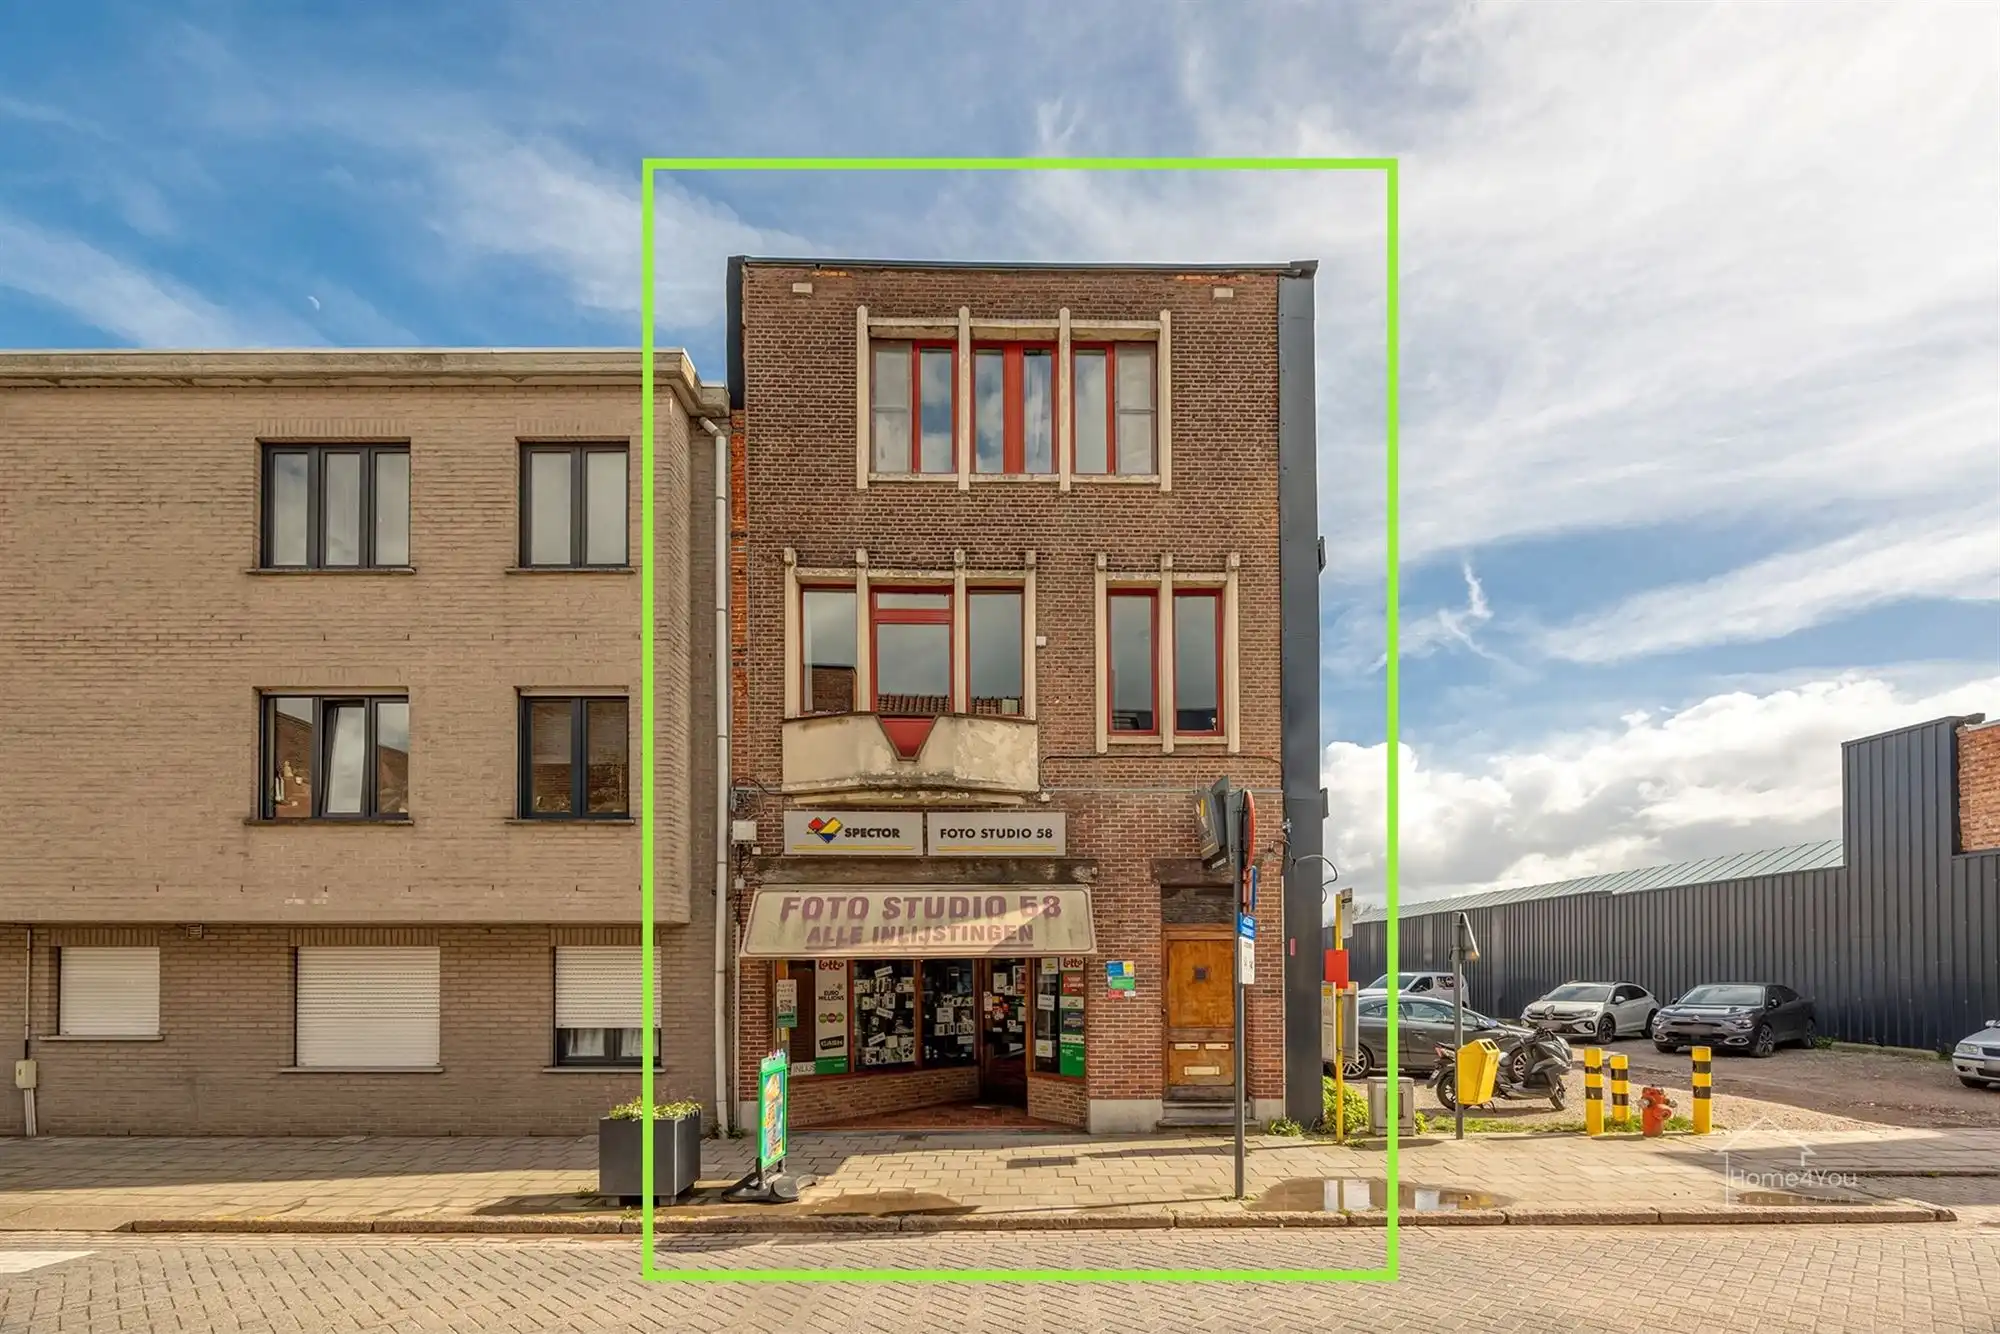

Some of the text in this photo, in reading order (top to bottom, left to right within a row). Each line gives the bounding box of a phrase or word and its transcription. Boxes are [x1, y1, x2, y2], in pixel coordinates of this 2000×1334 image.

[844, 828, 900, 838] SPECTOR
[940, 828, 1053, 839] FOTO STUDIO 58
[780, 895, 1062, 920] FOTO STUDIO 58
[806, 924, 1034, 945] ALLE INLIJSTINGEN
